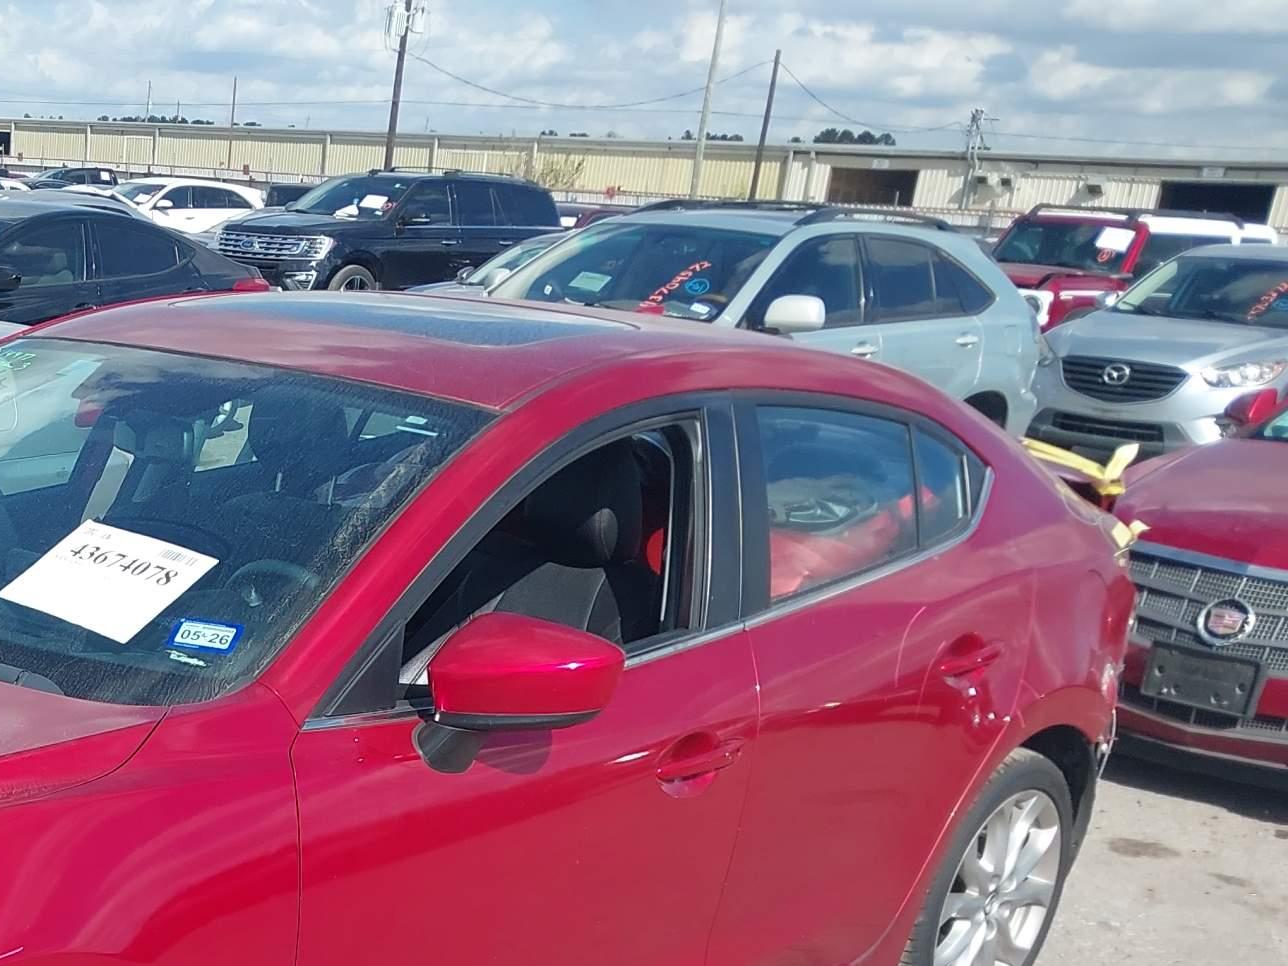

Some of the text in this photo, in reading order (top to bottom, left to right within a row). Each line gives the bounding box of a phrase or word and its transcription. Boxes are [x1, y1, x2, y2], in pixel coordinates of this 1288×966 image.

[69, 543, 179, 586] 43674078
[180, 629, 232, 646] 05 26
